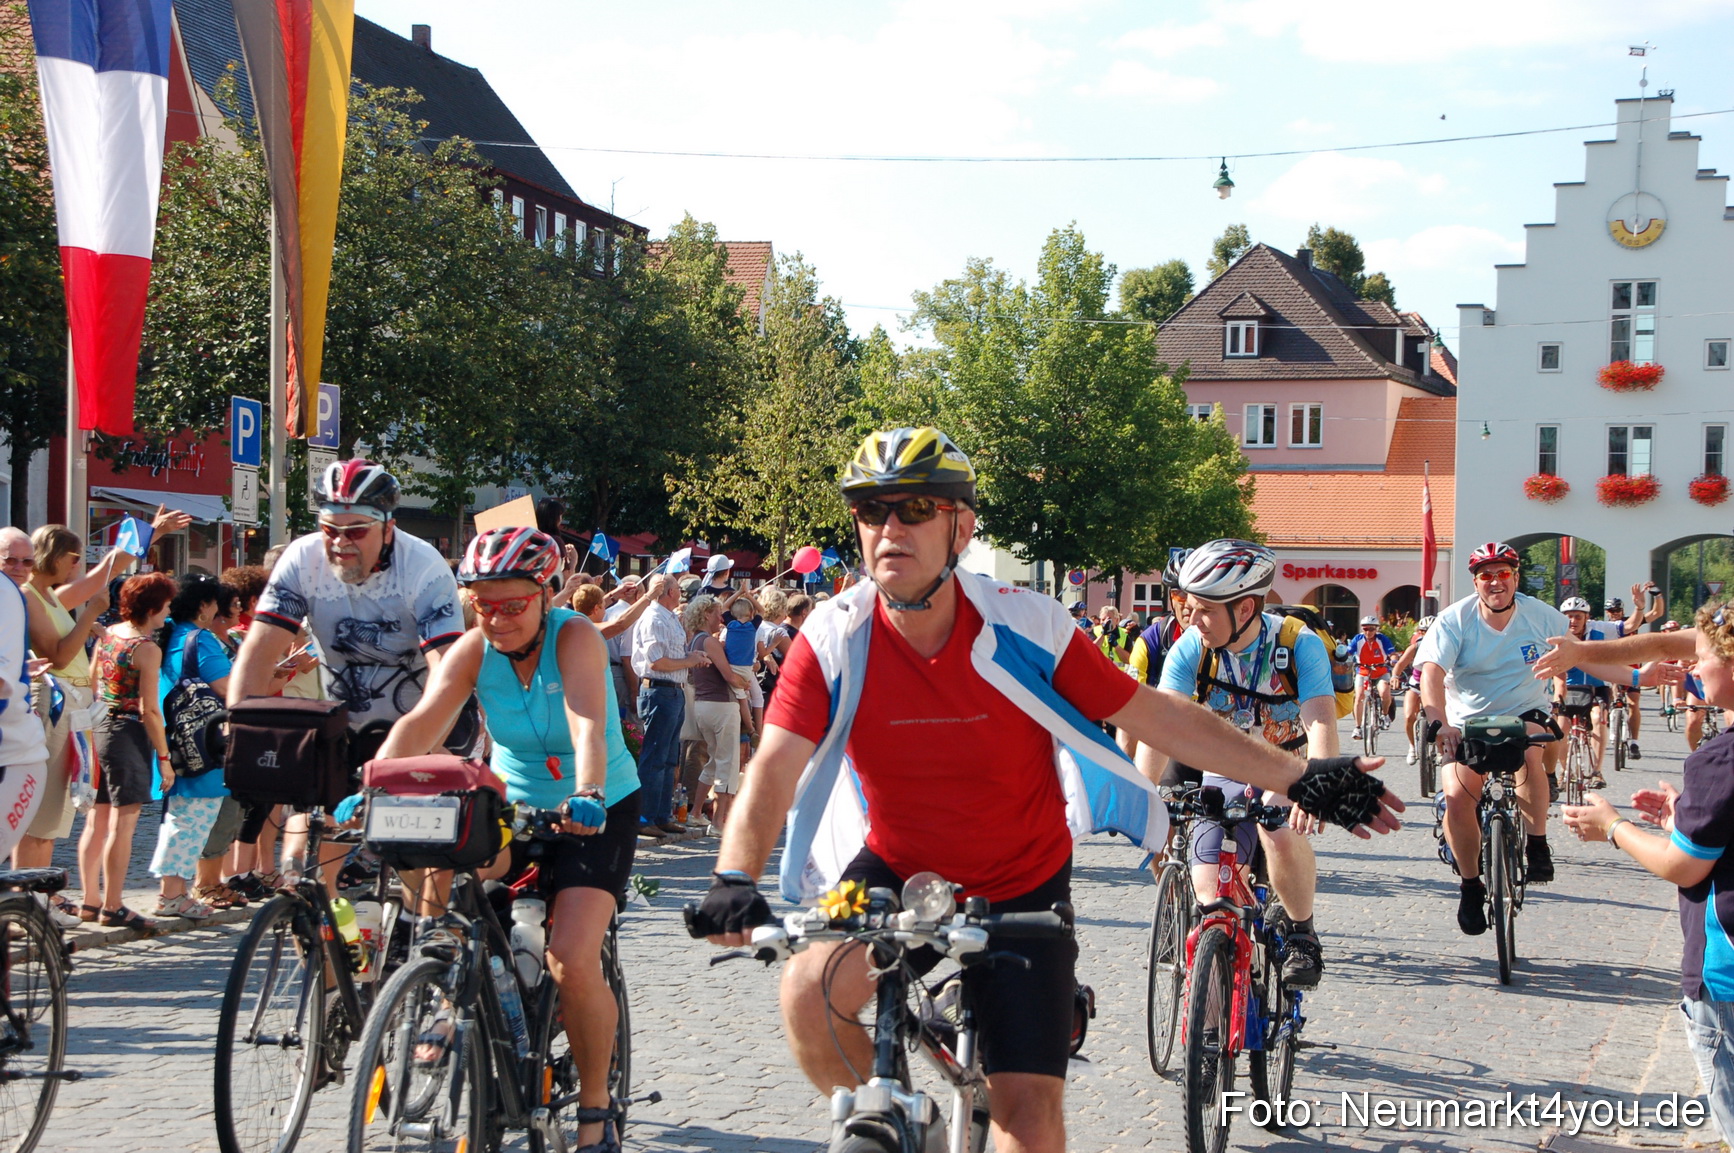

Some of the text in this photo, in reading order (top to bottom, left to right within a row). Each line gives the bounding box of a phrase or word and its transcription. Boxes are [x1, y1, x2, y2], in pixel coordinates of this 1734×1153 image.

[238, 406, 255, 456] P
[316, 391, 332, 438] P
[1282, 563, 1378, 581] Sparkasse
[7, 773, 37, 831] BOSCH
[433, 817, 442, 830] 2
